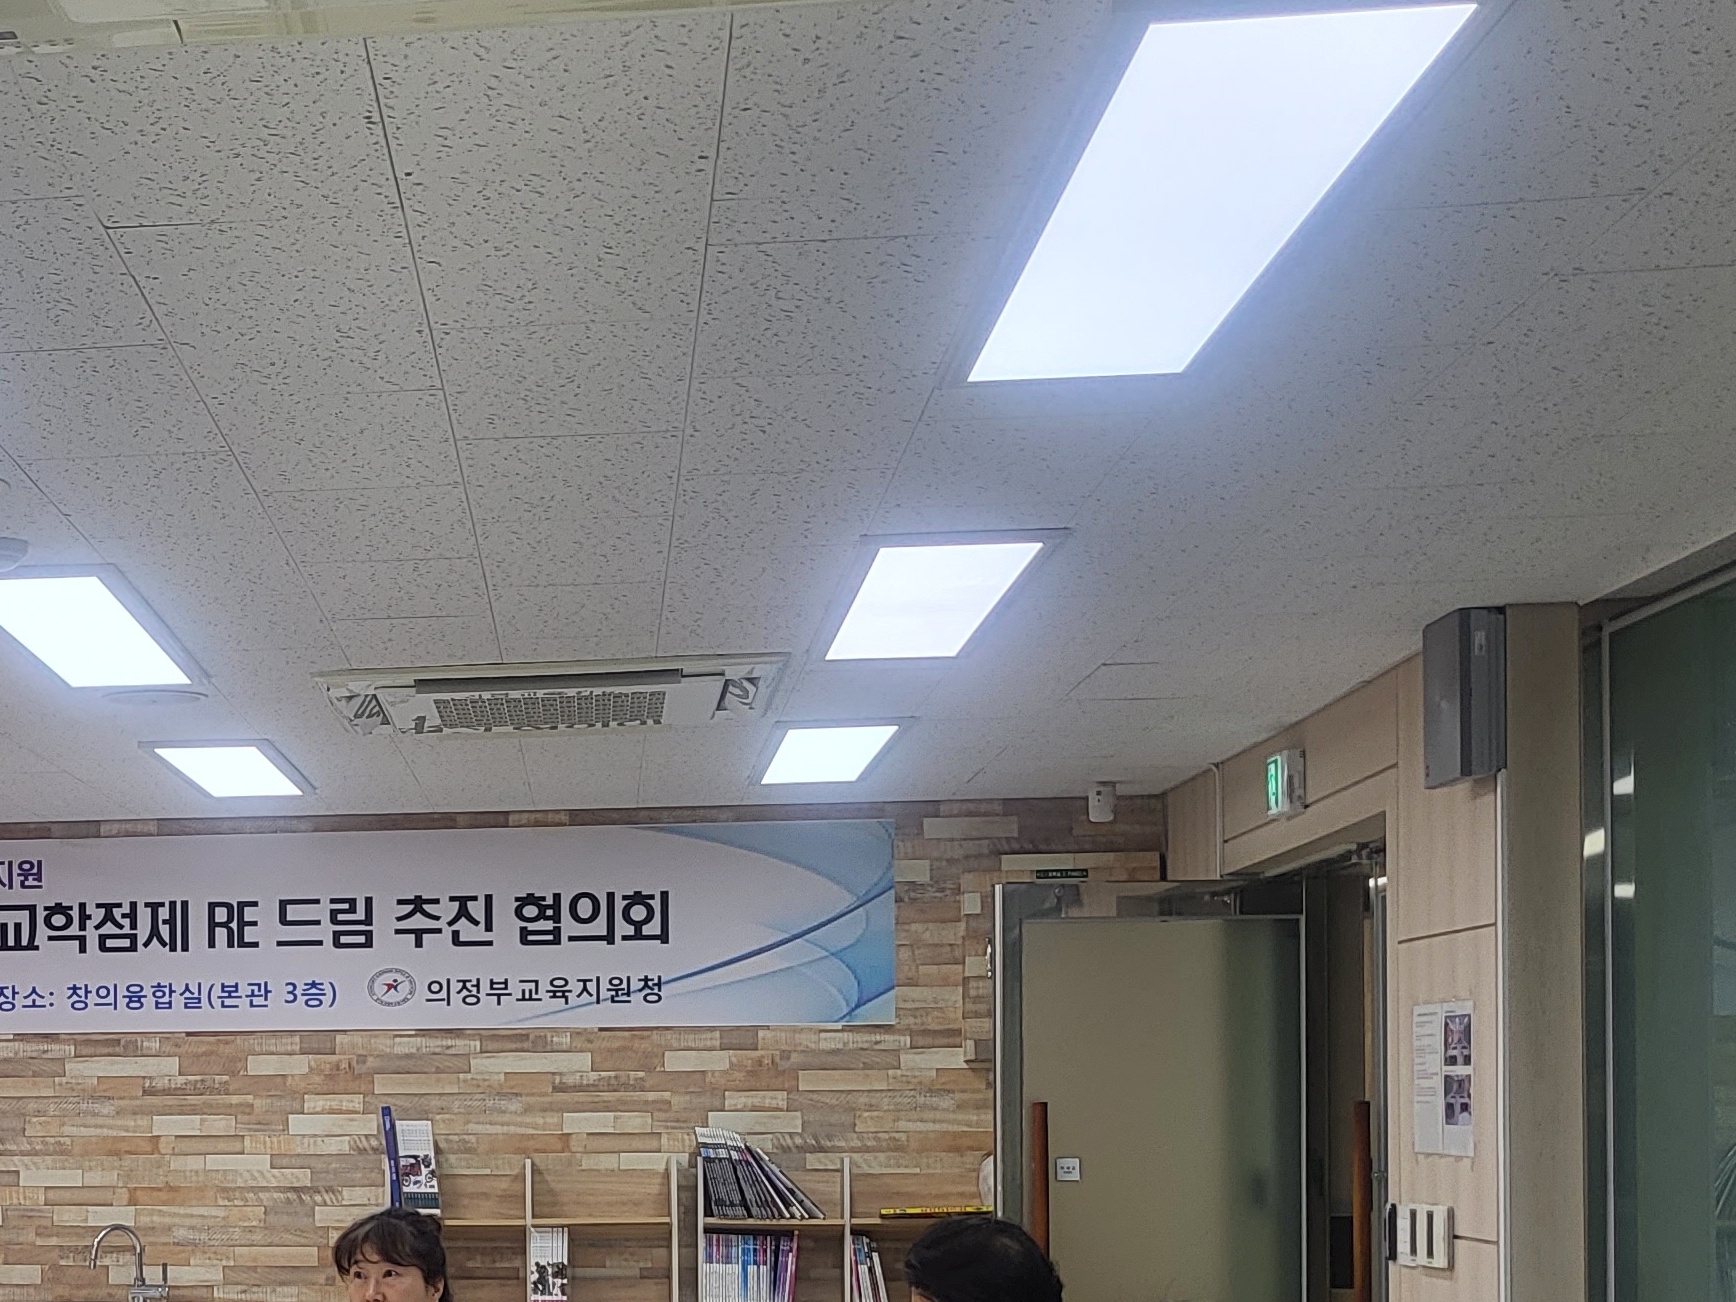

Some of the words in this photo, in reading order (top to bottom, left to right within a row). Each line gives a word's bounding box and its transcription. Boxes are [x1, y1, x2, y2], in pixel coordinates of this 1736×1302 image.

[207, 900, 260, 949] RE
[275, 897, 374, 950] 드림
[393, 894, 494, 948] 추진
[514, 890, 670, 946] 협의회
[66, 980, 273, 1011] 창의융합실(본관
[284, 979, 337, 1009] 3층)
[425, 973, 664, 1006] 의정부교육지원청
